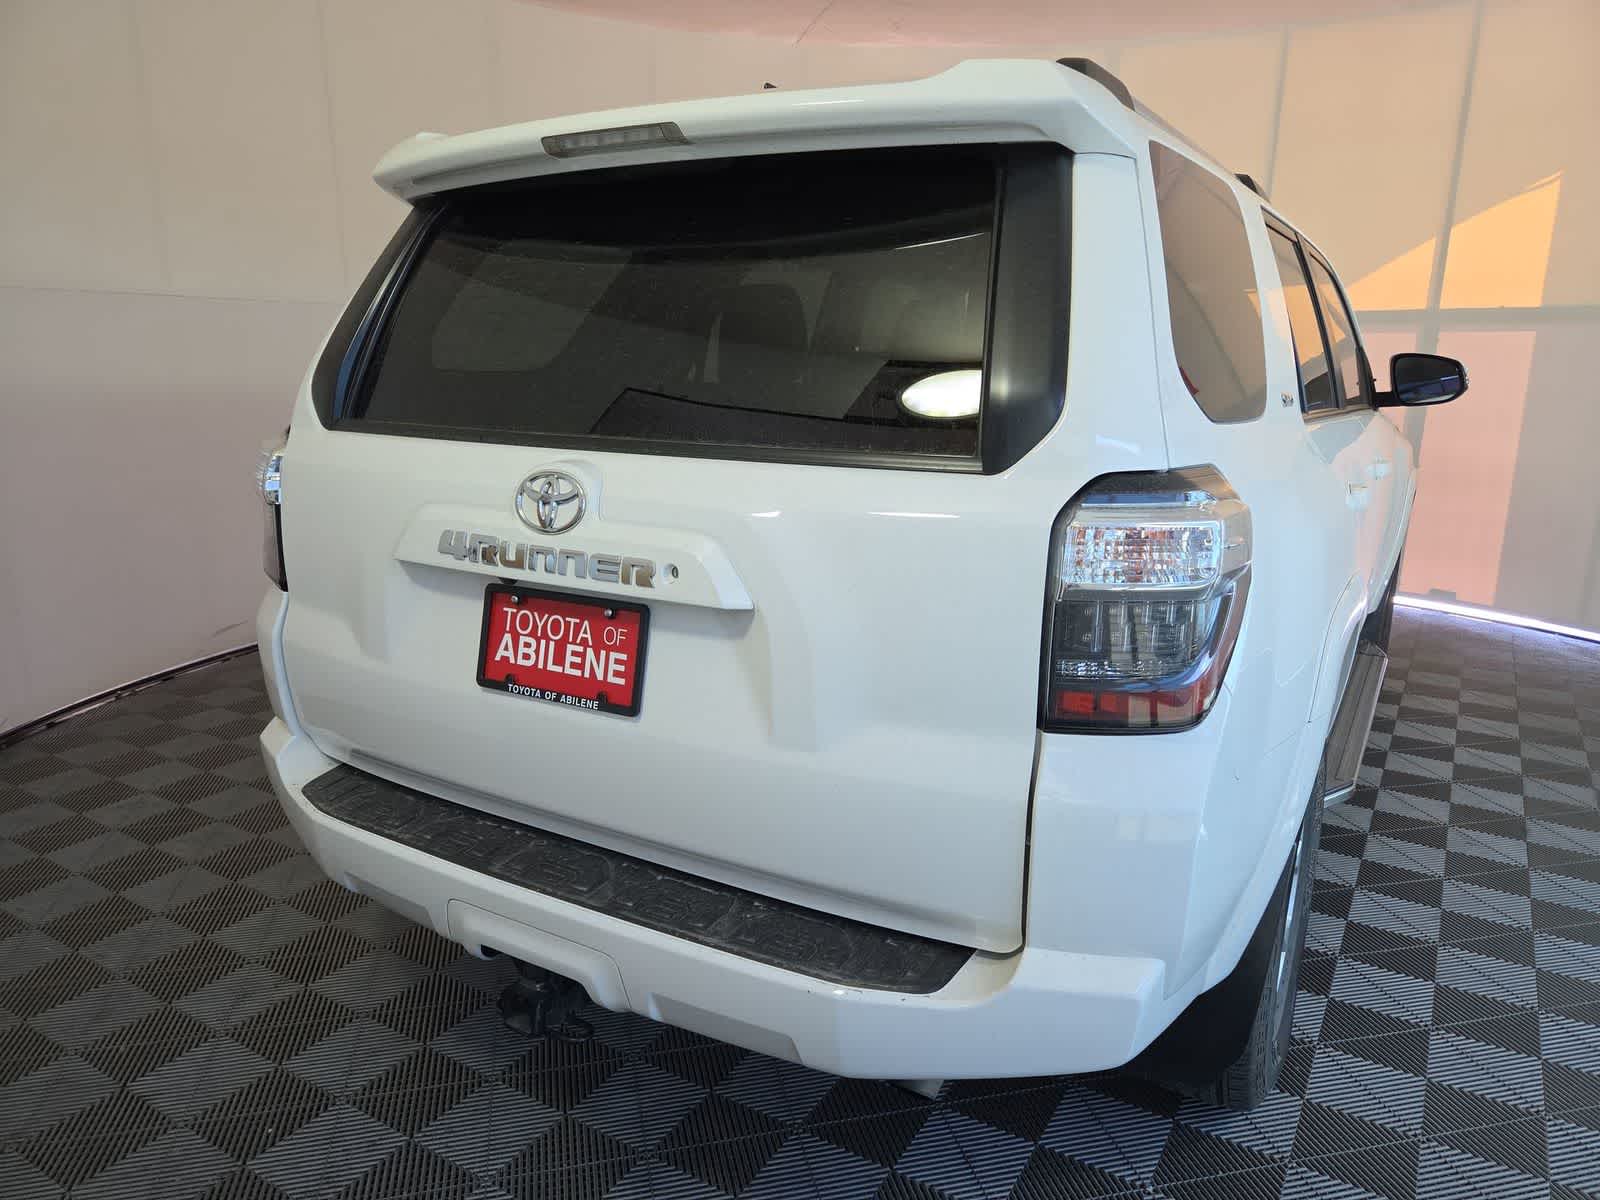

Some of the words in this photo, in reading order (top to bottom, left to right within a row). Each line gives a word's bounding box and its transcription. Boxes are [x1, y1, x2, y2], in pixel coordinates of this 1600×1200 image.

[503, 607, 592, 646] TOYOTA
[603, 626, 628, 647] OF
[495, 633, 628, 685] ABILENE
[507, 683, 541, 699] TOYOTA
[544, 690, 557, 700] OF
[560, 694, 599, 710] ABILENE
